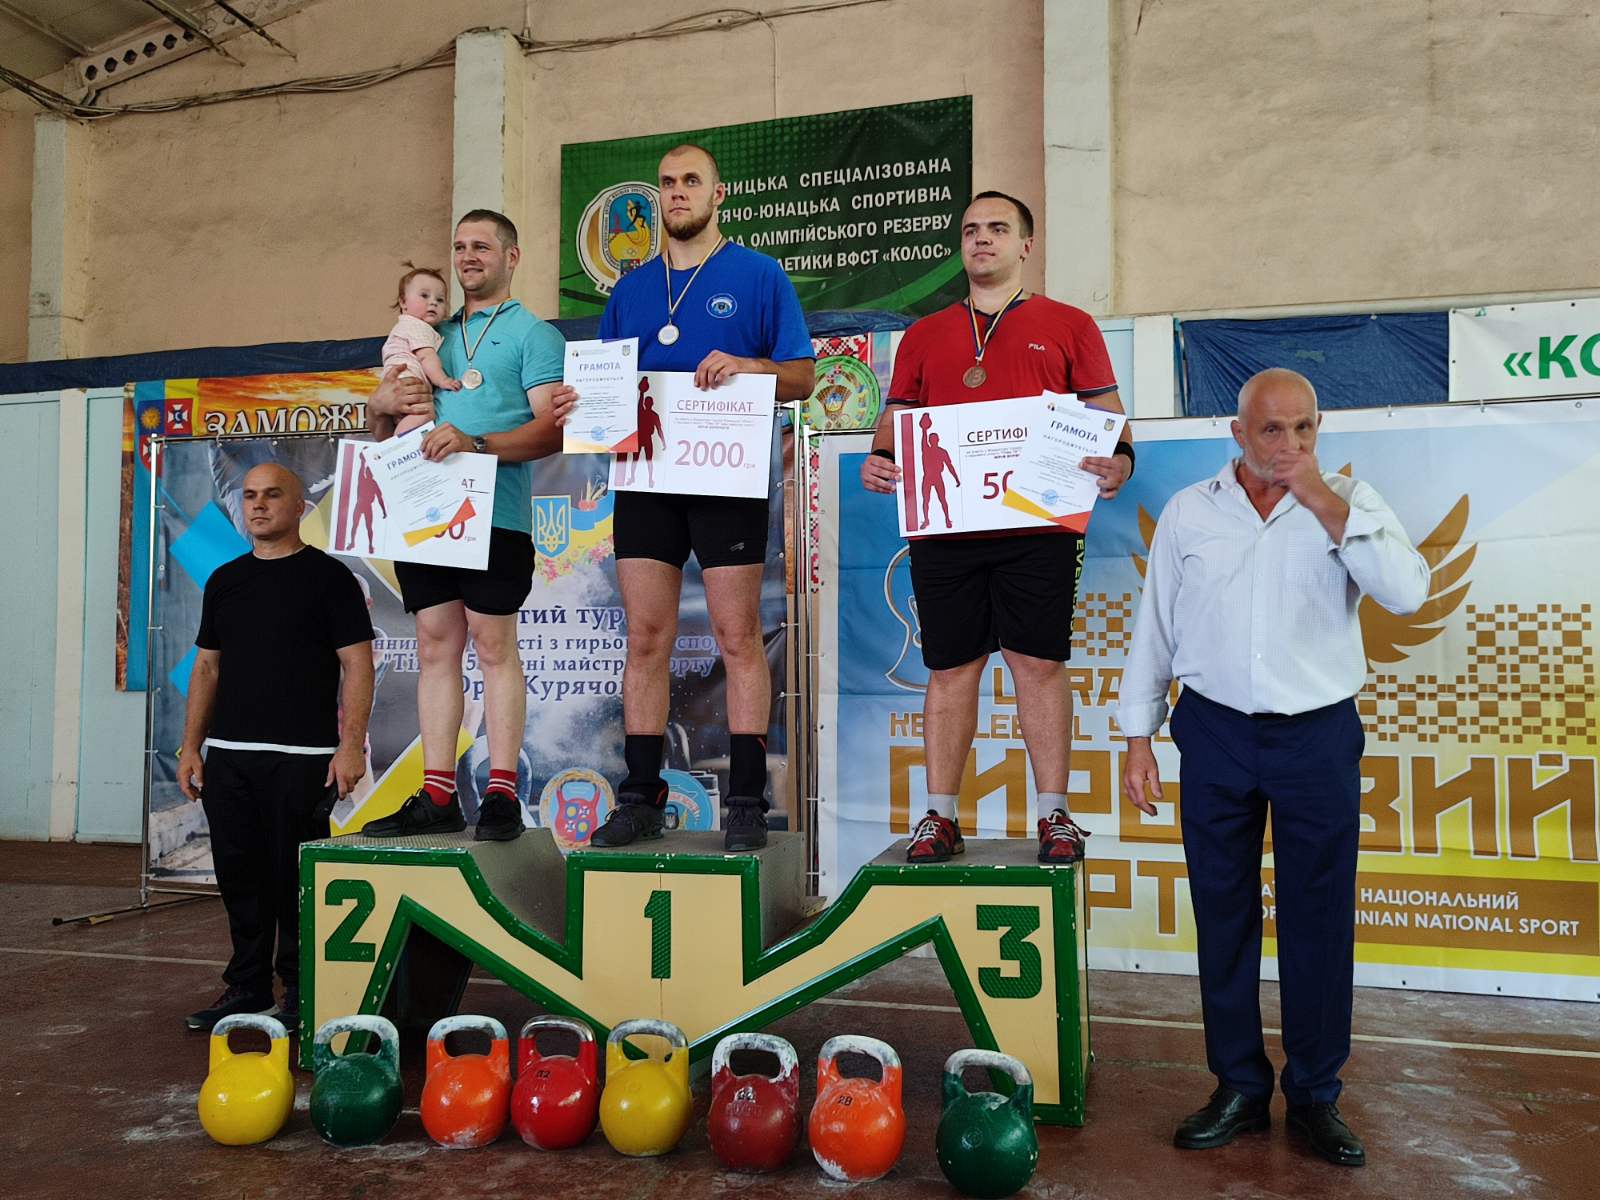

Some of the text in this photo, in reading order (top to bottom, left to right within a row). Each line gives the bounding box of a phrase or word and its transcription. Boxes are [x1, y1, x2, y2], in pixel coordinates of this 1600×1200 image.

[724, 157, 952, 197] НИЦЬКА СПЕЦІАЛІЗОВАНА
[716, 186, 952, 224] ТЯЧО-ЮНАЦЬКА СПОРТИВНА
[751, 222, 877, 248] ОЛІМПІЙСЬКОГО
[884, 214, 953, 235] РЕЗЕРВУ
[837, 249, 880, 267] ВФСТ
[883, 243, 952, 263] «КОЛОС»
[1028, 343, 1046, 352] FILA
[579, 361, 621, 372] ГРАМОТА
[676, 399, 755, 413] СЕРТИФІКАТ
[967, 426, 1028, 443] СЕРТИФІ
[1050, 420, 1098, 443] ГРАМОТА
[674, 439, 745, 469] 2000
[519, 604, 625, 630] тий тур
[517, 634, 543, 650] сті
[550, 639, 558, 650] з
[565, 639, 628, 654] гирьо
[553, 655, 624, 676] майстр
[1360, 887, 1519, 911] НАЦІОНАЛЬНИЙ
[325, 878, 376, 963] 2
[1414, 912, 1514, 933] NATIONAL
[1518, 917, 1580, 937] SPORT
[643, 889, 672, 980] 1
[976, 904, 1043, 999] 3
